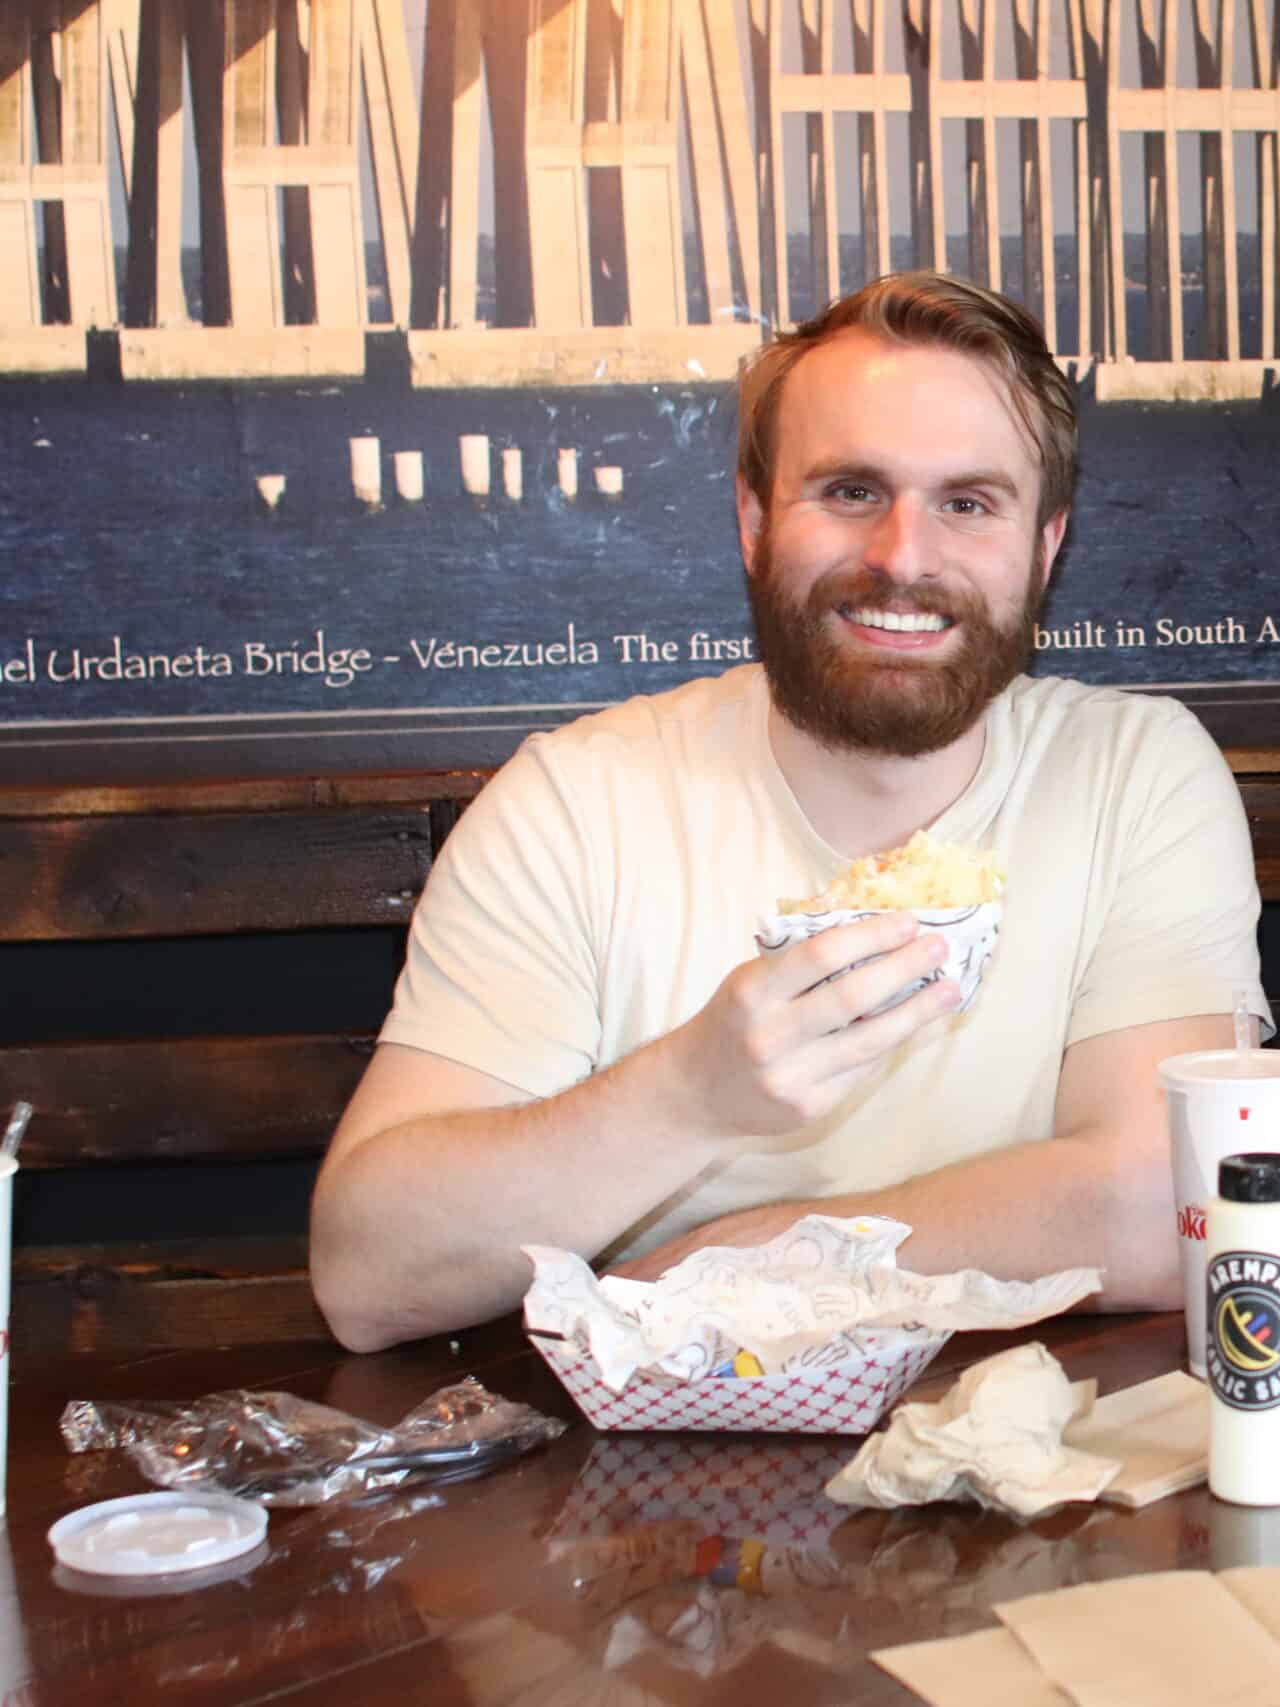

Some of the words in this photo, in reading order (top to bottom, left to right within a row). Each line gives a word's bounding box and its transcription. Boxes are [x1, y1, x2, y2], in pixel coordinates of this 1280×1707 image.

[0, 638, 36, 682] el
[48, 636, 233, 681] Urdaneta
[244, 629, 373, 688] Bridge
[613, 633, 679, 663] The
[688, 632, 754, 660] first
[1034, 620, 1106, 649] built
[1116, 620, 1146, 648] in
[1156, 616, 1248, 646] South
